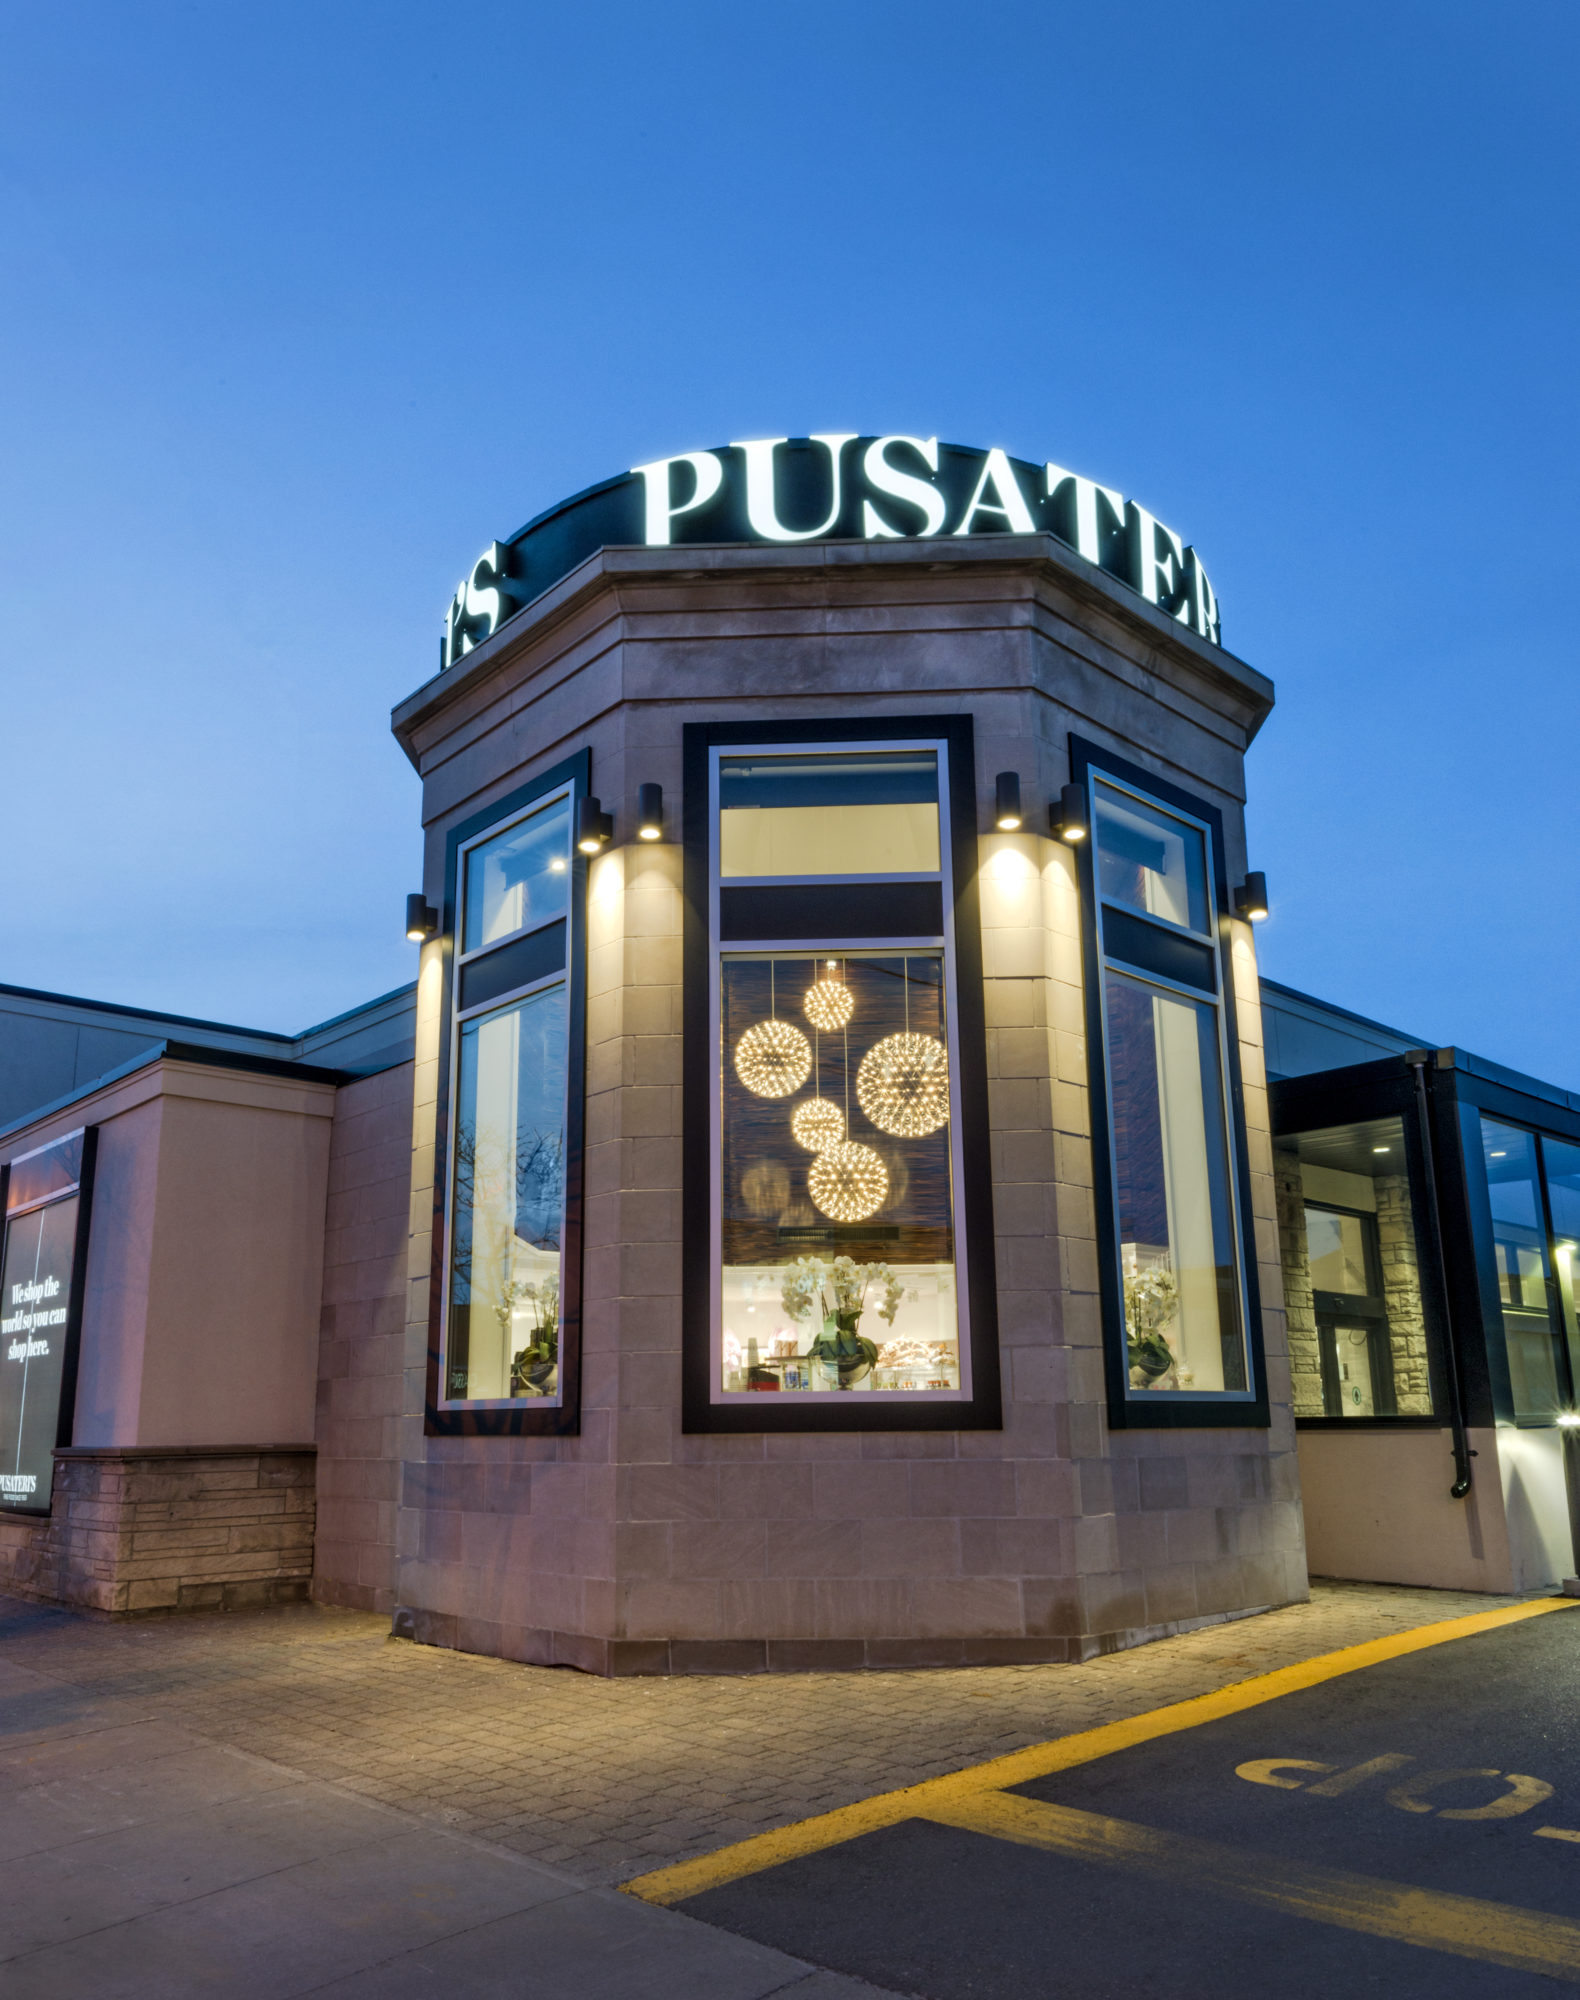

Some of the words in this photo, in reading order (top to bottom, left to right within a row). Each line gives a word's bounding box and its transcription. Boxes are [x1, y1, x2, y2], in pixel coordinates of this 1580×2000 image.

[12, 1283, 24, 1305] We
[24, 1280, 44, 1305] shop
[44, 1275, 60, 1298] the
[1, 1309, 24, 1334] world
[23, 1316, 32, 1330] so
[31, 1310, 49, 1333] you
[49, 1308, 66, 1325] can
[8, 1338, 27, 1363] shop
[27, 1335, 50, 1357] here.
